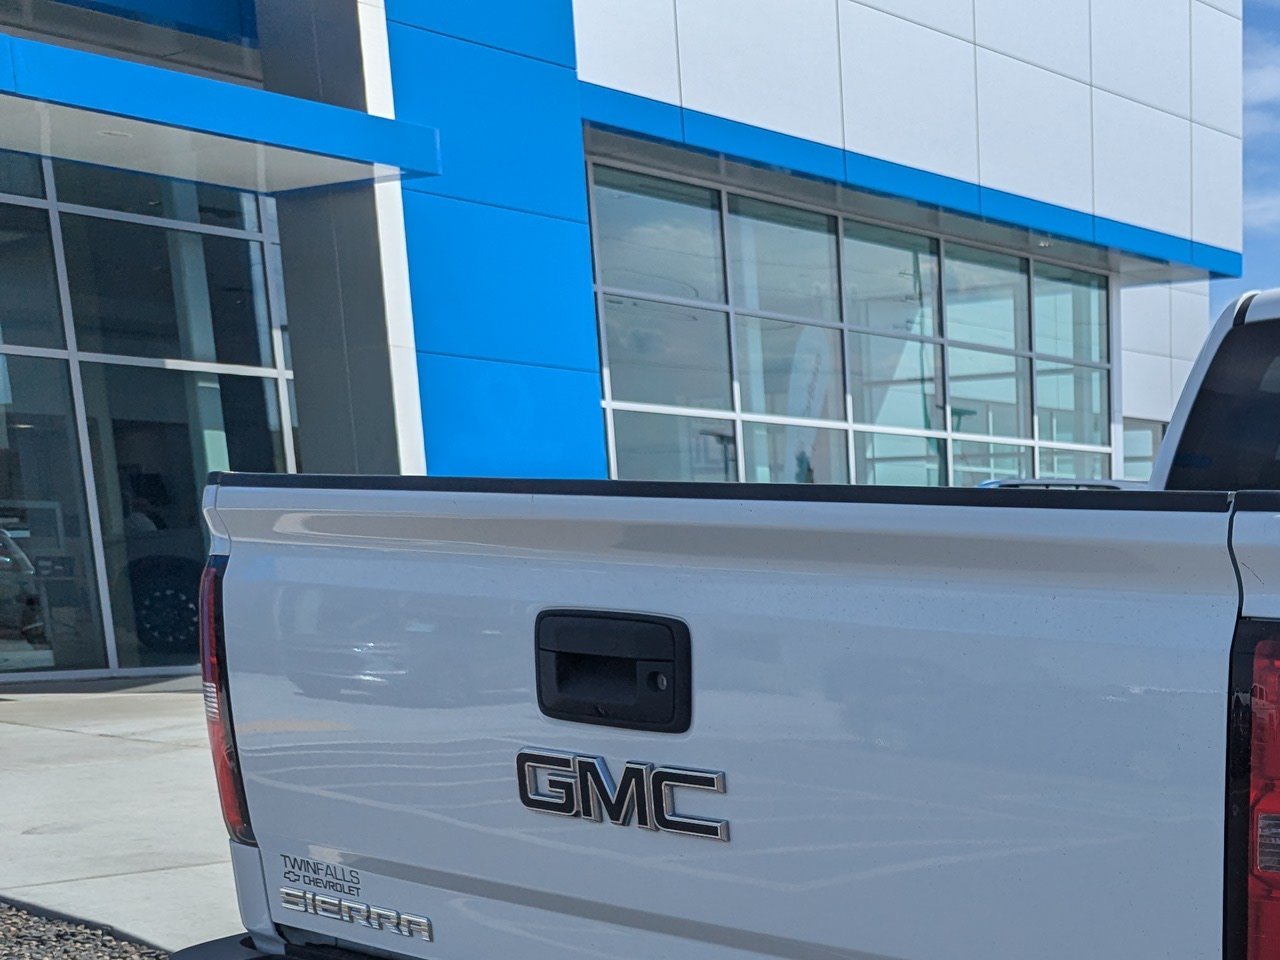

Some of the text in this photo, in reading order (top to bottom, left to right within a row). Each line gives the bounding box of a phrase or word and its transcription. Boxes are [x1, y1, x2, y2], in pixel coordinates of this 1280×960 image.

[516, 746, 731, 842] GMC
[280, 854, 361, 884] TWINFALLS
[303, 875, 361, 896] CHEVROLET
[280, 886, 434, 942] SIERRA
